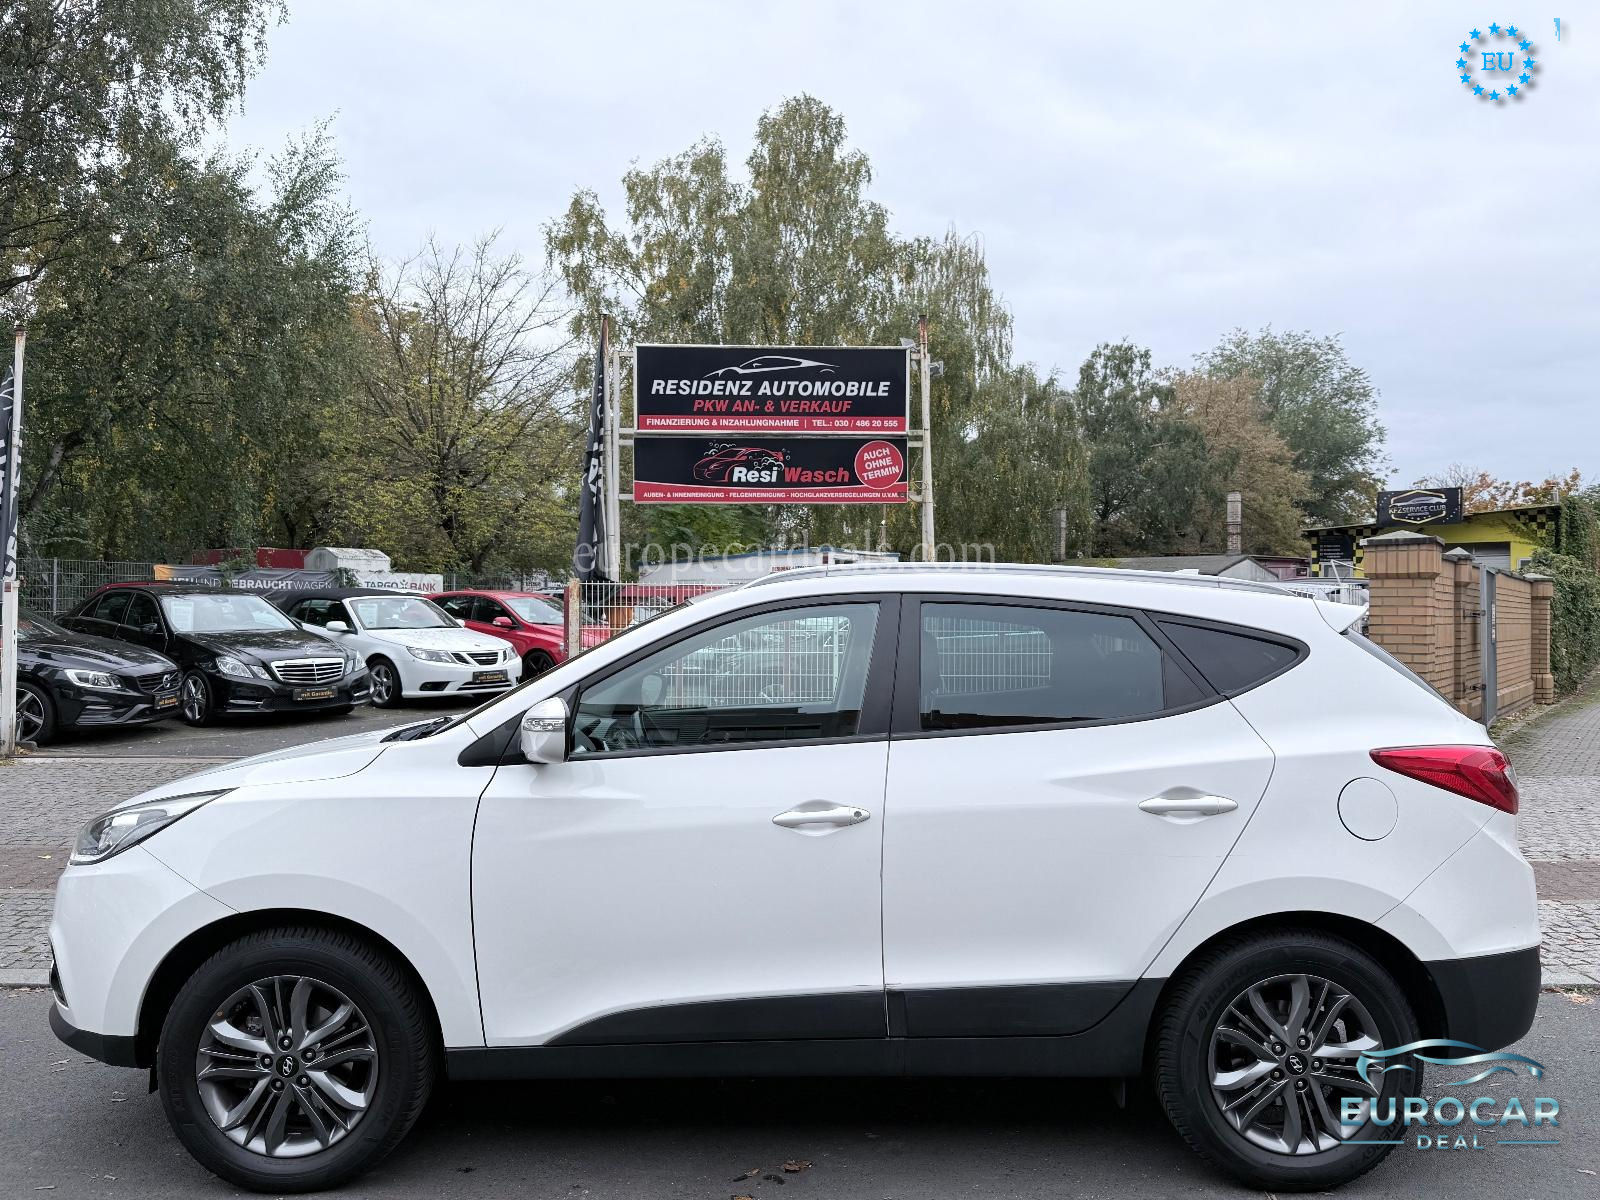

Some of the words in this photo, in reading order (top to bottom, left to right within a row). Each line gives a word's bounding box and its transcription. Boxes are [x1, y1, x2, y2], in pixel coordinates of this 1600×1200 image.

[651, 380, 753, 395] RESIDENZ
[758, 381, 891, 397] AUTOMOBILE
[693, 400, 729, 412] PKW
[732, 400, 760, 412] AN-
[764, 400, 775, 412] &
[780, 400, 852, 413] VERKAUF
[646, 418, 710, 426] FINANZIERUNG
[711, 418, 718, 426] &
[720, 419, 799, 427] INZAHLUNGNAHME
[863, 448, 890, 461] AUCH
[864, 457, 893, 470] OHNE
[732, 467, 778, 482] Resi
[784, 467, 850, 482] Wasch
[862, 466, 900, 481] TERMIN
[1429, 504, 1447, 512] CLUB
